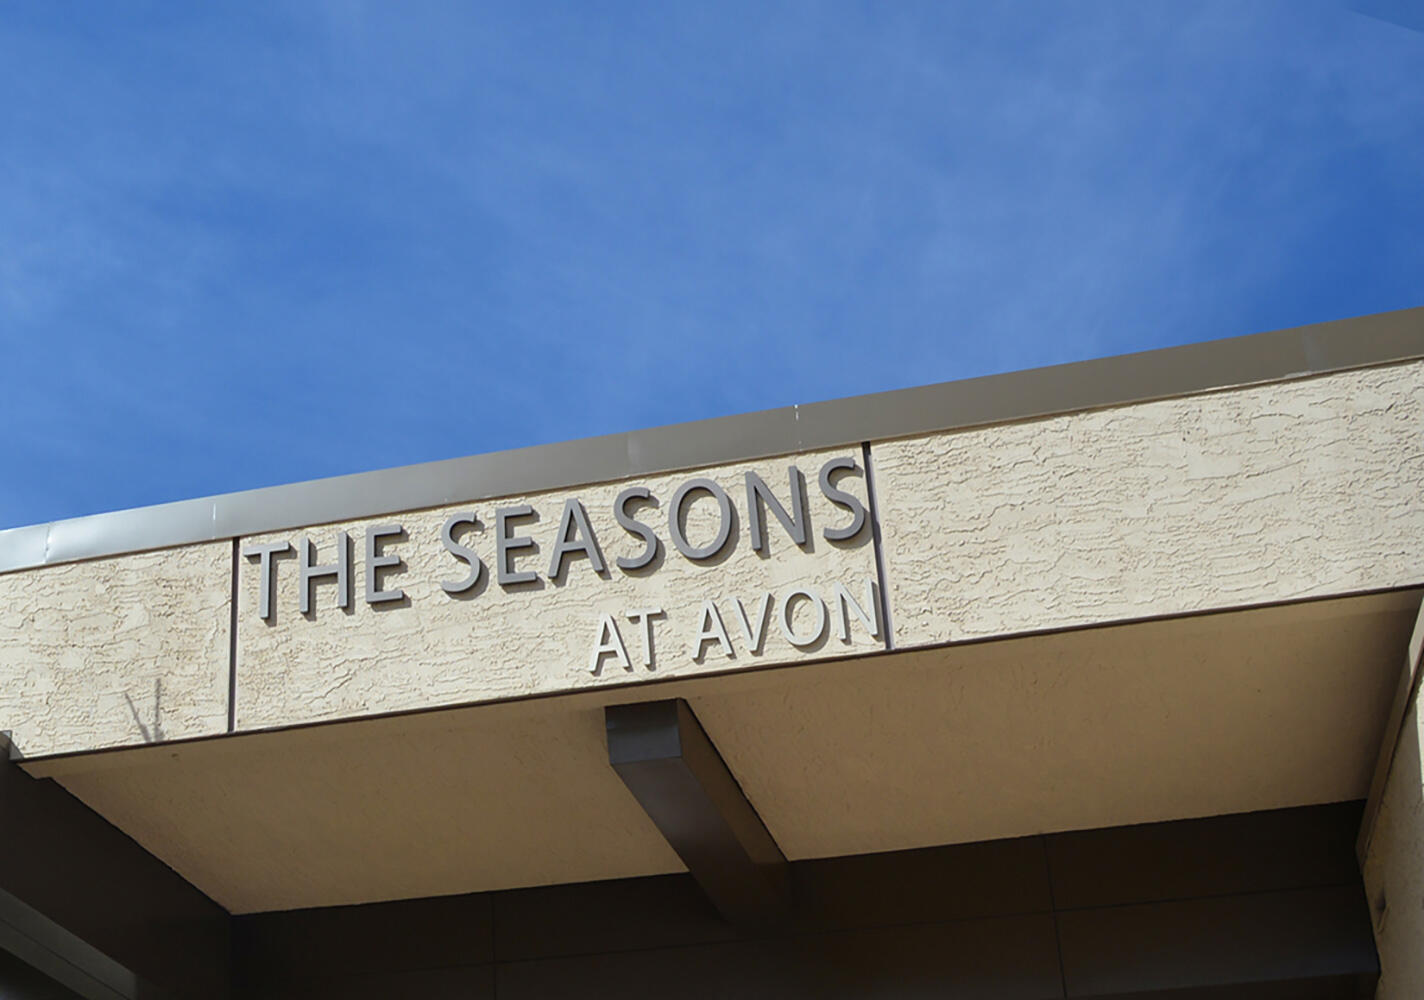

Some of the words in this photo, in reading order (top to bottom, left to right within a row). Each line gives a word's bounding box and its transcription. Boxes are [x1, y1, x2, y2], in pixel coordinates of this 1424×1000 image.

[243, 524, 408, 619] THE
[440, 456, 869, 593] SEASONS
[588, 607, 663, 674] AT
[692, 578, 880, 661] AVON
